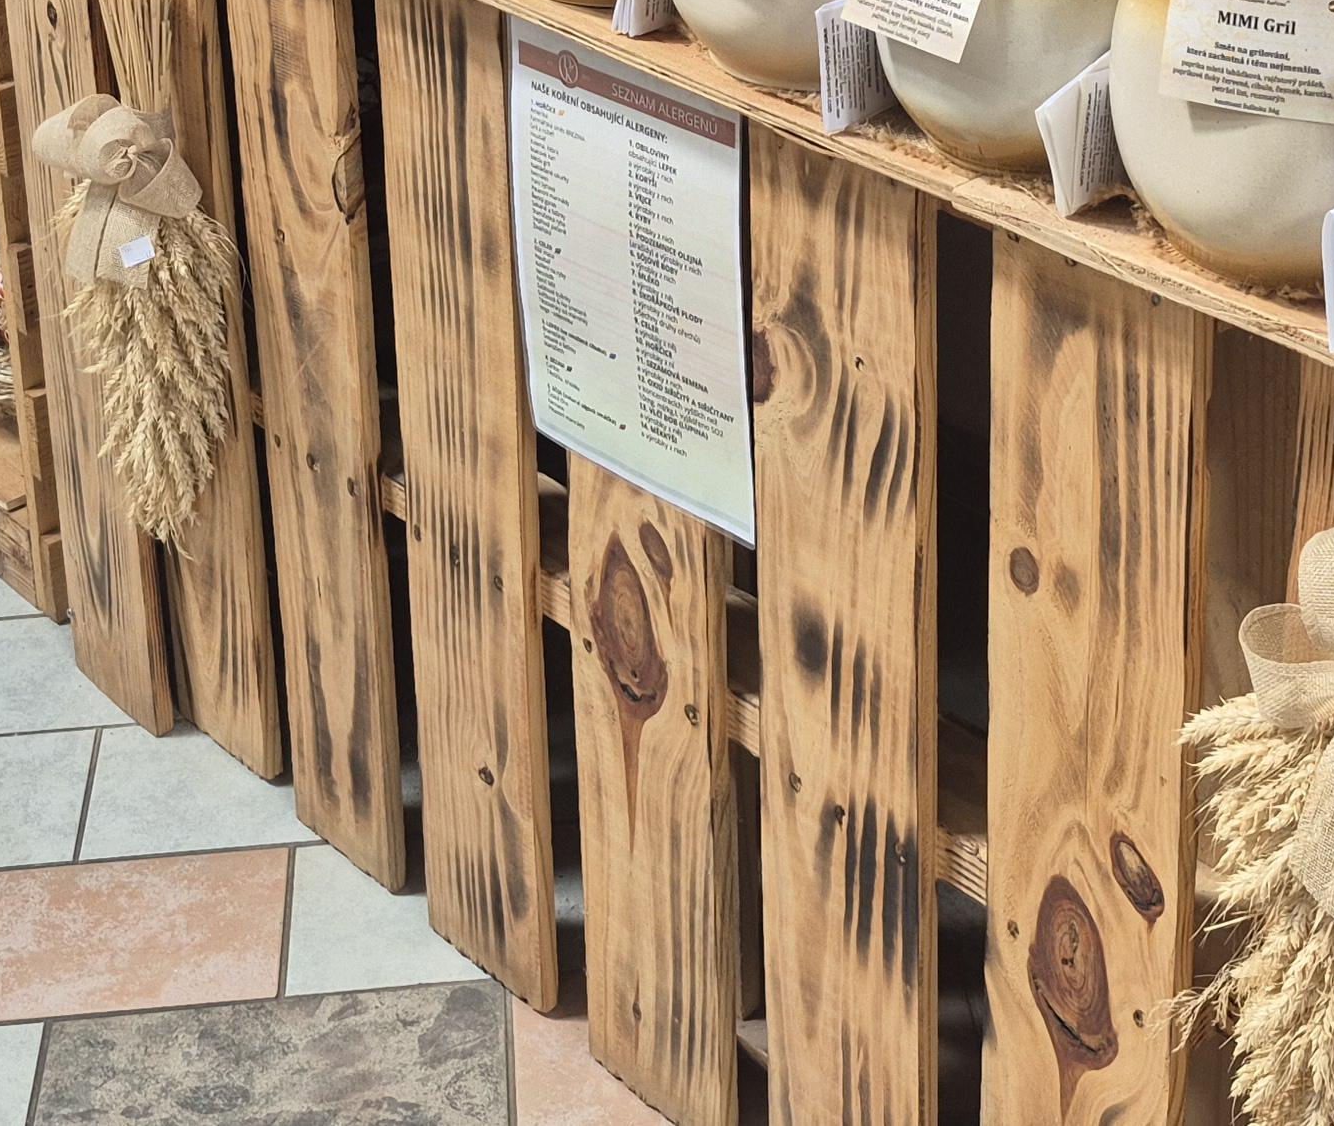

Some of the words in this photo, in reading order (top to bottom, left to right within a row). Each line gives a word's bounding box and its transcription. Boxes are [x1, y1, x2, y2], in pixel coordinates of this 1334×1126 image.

[1217, 9, 1259, 31] MIMI
[1263, 18, 1297, 36] Gril
[1186, 46, 1208, 59] která
[1207, 51, 1246, 67] zachutná
[1250, 57, 1268, 69] těm
[1269, 61, 1322, 76] nejmenším.
[1214, 40, 1237, 54] Směs
[1237, 46, 1248, 55] na
[1248, 47, 1291, 62] grilování,
[531, 80, 551, 96] NAŠE
[550, 88, 580, 107] KOŘENÍ
[580, 99, 625, 126] OBSAHUJÍCÍ
[625, 120, 668, 144] ALERGENY:
[610, 82, 657, 111] SEZNAM
[658, 104, 718, 136] ALERGENŮ
